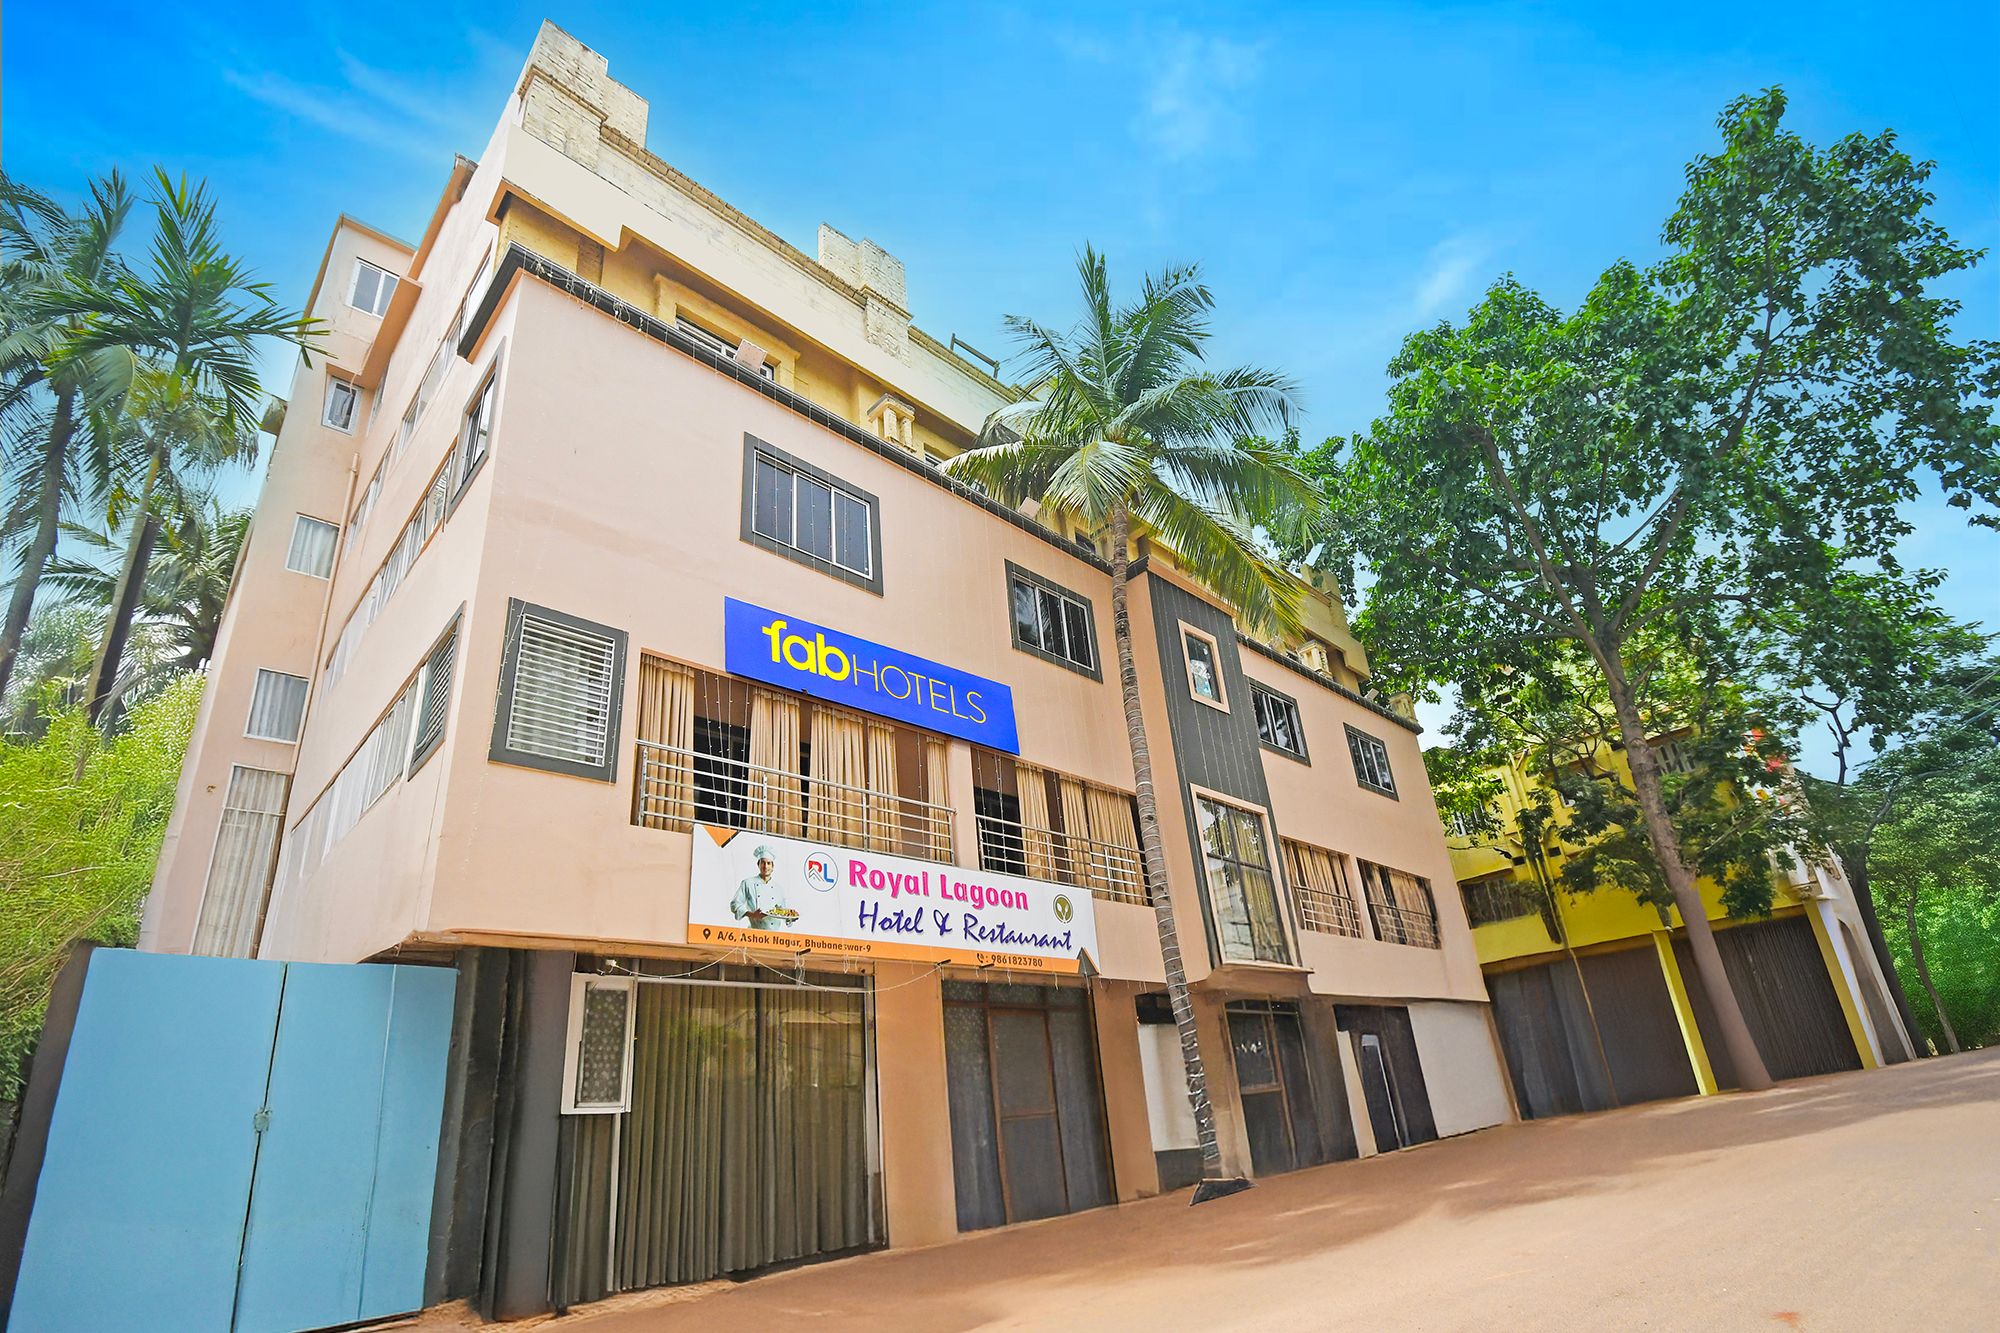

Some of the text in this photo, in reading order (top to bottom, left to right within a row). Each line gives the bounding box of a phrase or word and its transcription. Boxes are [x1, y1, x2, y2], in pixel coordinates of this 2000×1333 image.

[849, 860, 1028, 910] Royal Lagoon
[717, 931, 737, 942] A/6,
[740, 933, 769, 944] Ashok
[772, 936, 801, 948] Nagar,
[859, 900, 1072, 950] Hotel & Restaurant
